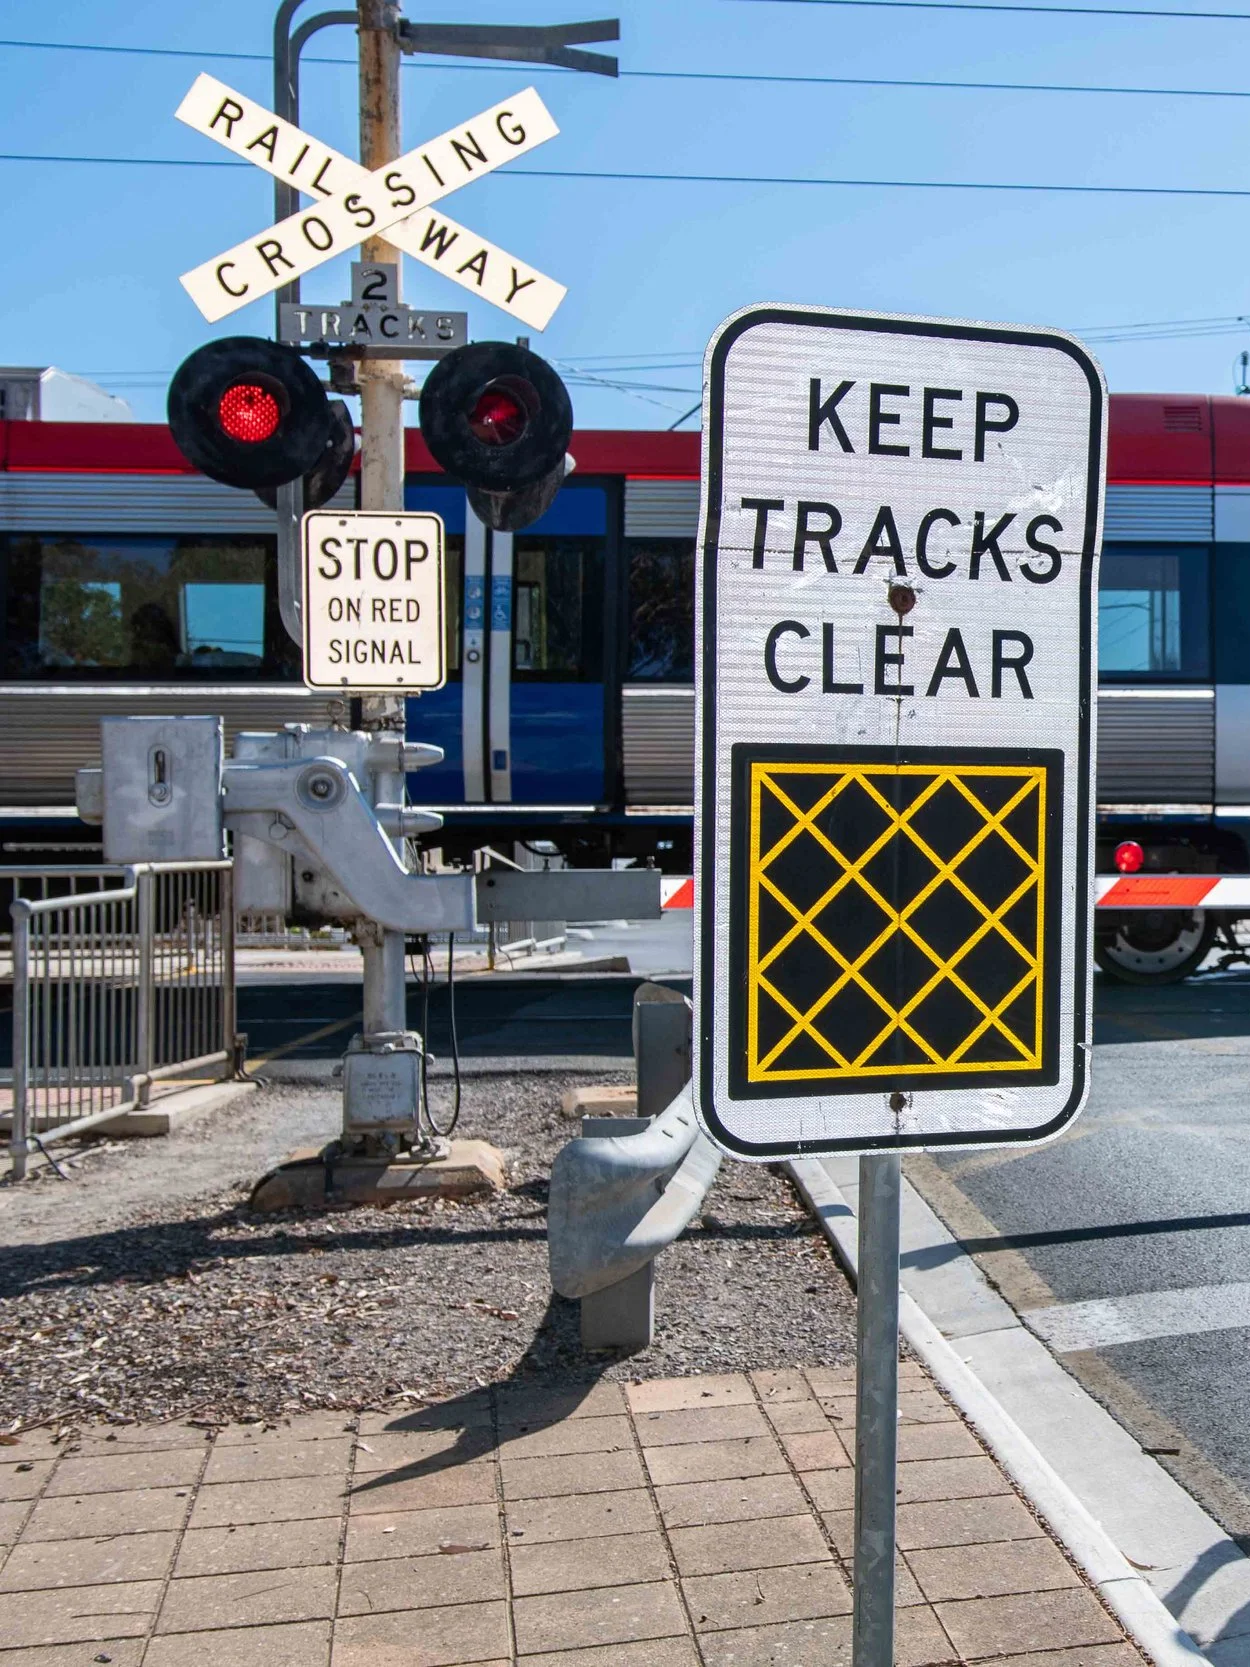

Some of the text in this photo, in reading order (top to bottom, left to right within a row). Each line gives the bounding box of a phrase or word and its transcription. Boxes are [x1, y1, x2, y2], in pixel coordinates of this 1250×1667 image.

[215, 110, 527, 297] CROSSING
[362, 269, 388, 302] 2
[293, 310, 455, 341] TRACKS
[807, 377, 1020, 463] KEEP
[318, 537, 429, 581] STOP
[740, 497, 1064, 585] TRACKS
[328, 597, 420, 622] ON RED
[328, 639, 421, 664] SIGNAL
[764, 619, 1035, 700] CLEAR
